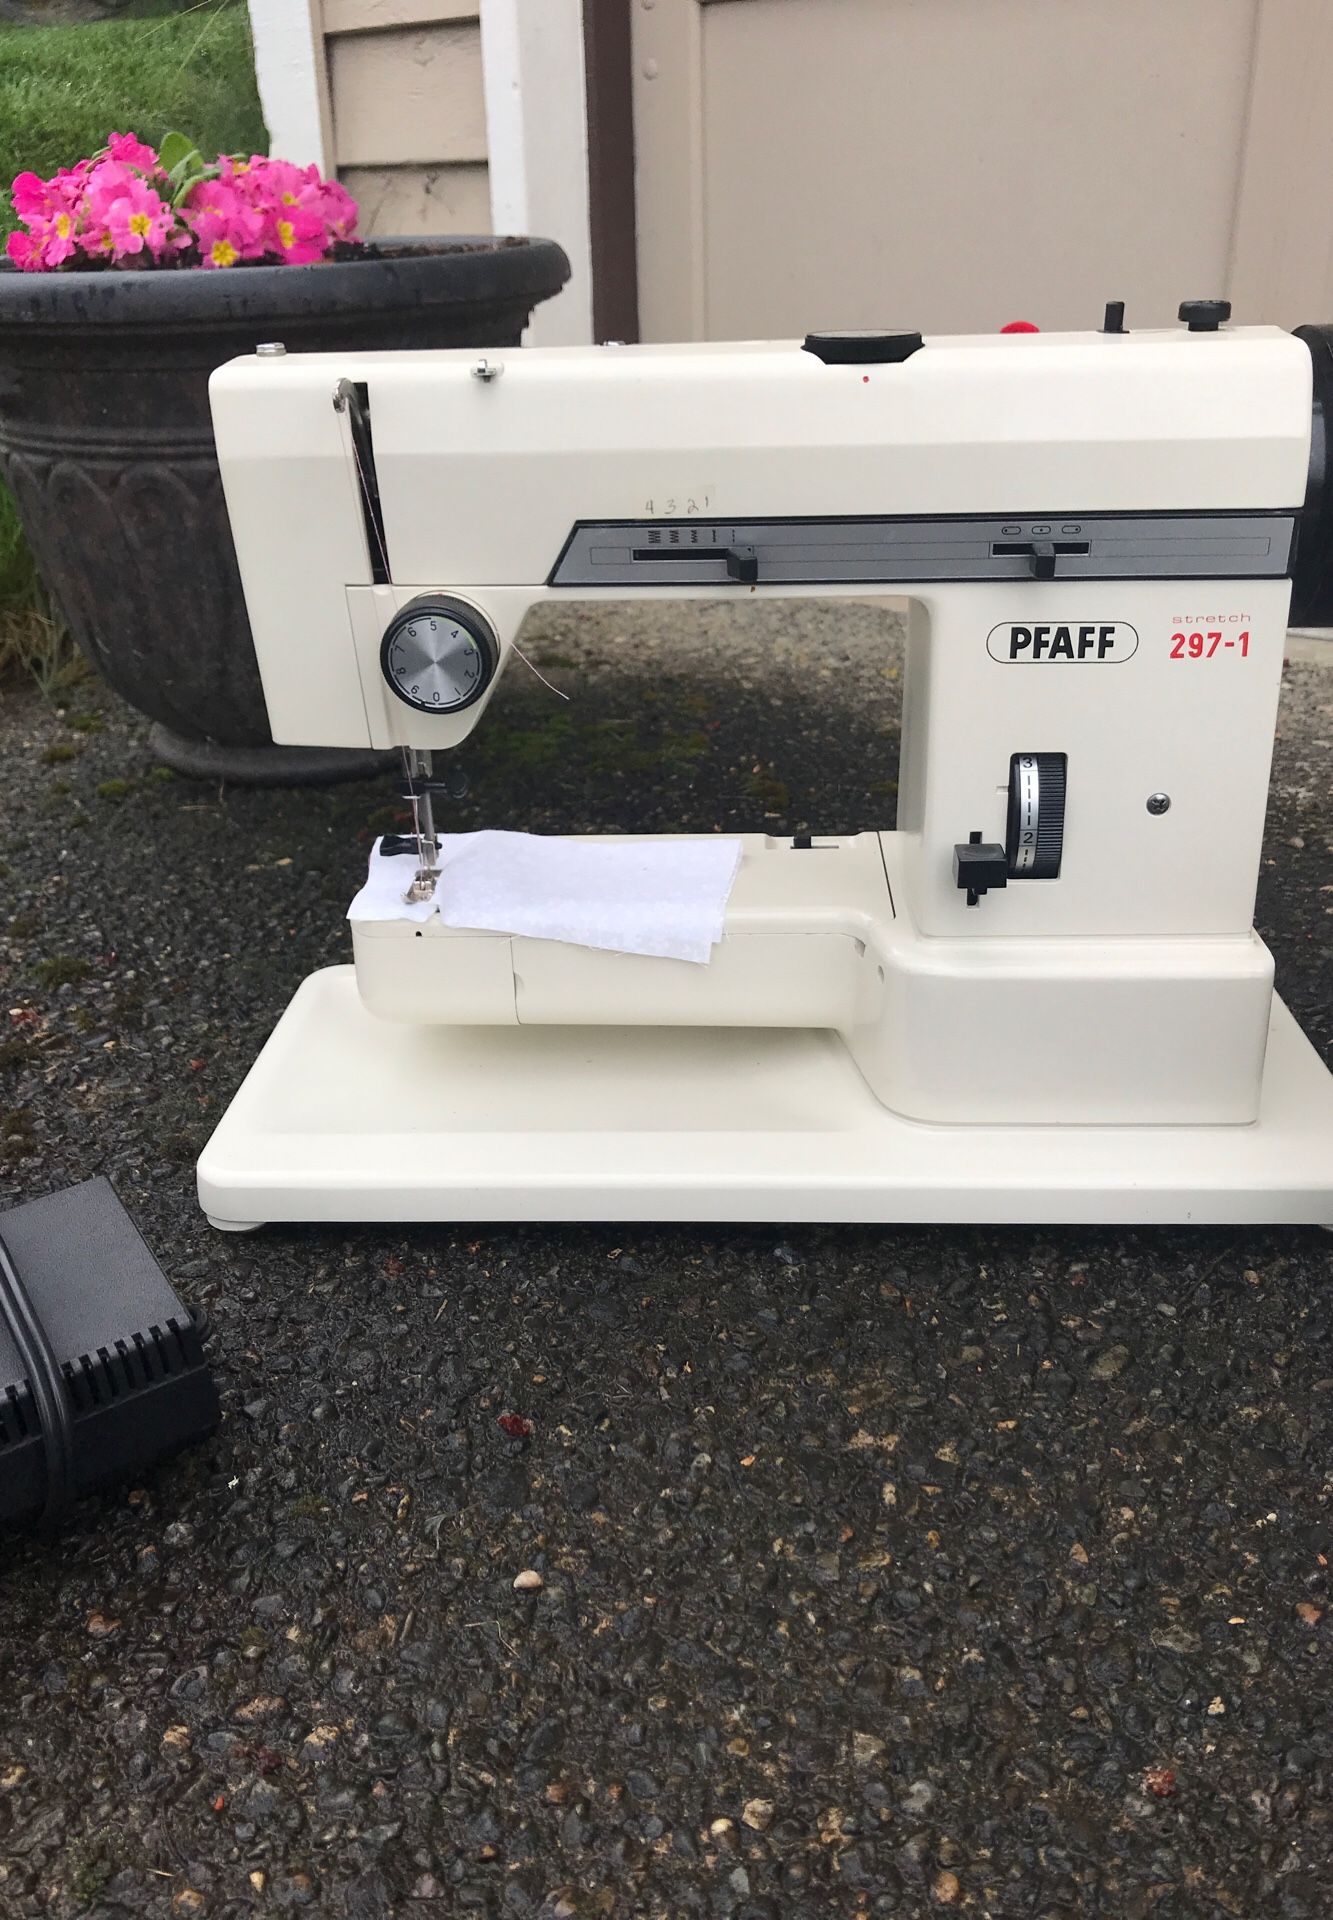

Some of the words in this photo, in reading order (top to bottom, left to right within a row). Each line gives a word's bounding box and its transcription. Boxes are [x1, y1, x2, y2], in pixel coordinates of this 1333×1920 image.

[644, 499, 655, 514] 4
[664, 499, 676, 515] 3
[687, 499, 699, 514] 2
[1172, 612, 1251, 624] stretch
[430, 620, 437, 631] 5
[407, 626, 417, 637] 6
[450, 630, 459, 639] 4
[1009, 626, 1116, 659] PFAFF
[1169, 631, 1250, 659] 297-1
[394, 645, 405, 653] 7
[463, 648, 474, 656] 3
[395, 667, 406, 675] 8
[464, 670, 475, 679] 2
[1022, 756, 1033, 768] 3
[1023, 832, 1034, 844] 2
